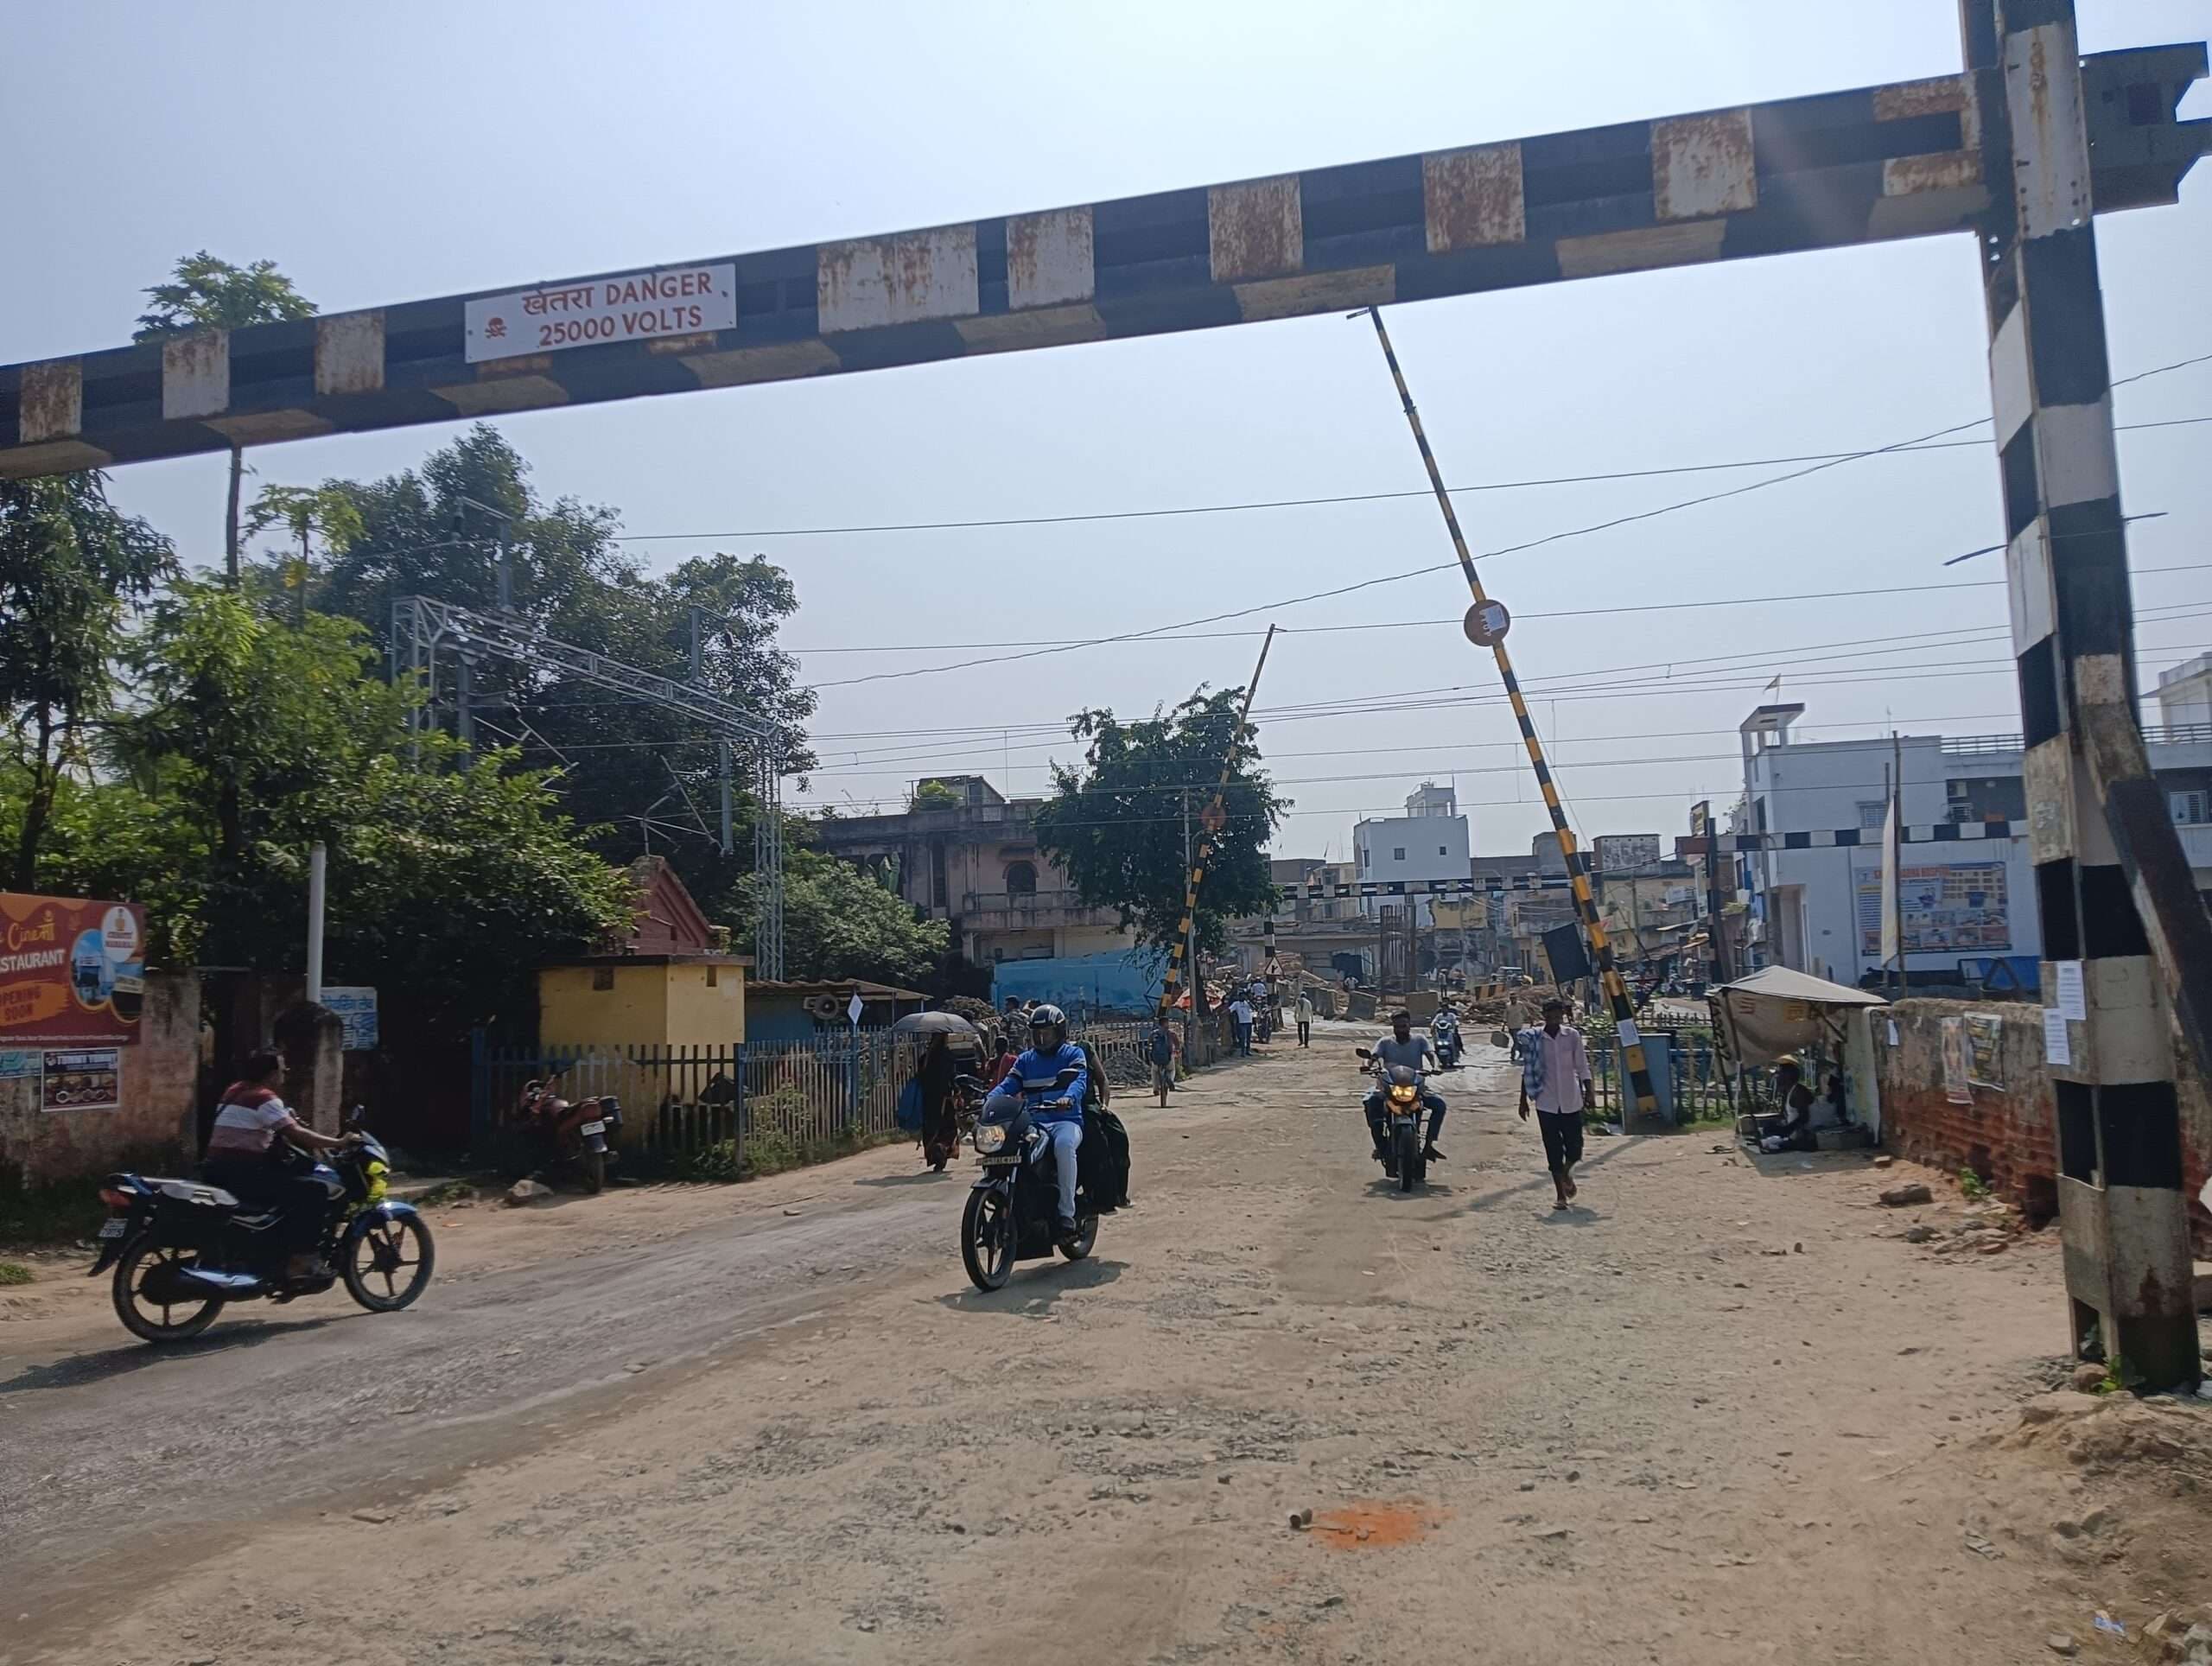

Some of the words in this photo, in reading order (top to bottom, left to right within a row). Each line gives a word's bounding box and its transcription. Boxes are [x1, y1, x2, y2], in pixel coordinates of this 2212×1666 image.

[607, 272, 711, 305] DANGER
[539, 316, 614, 346] 25000
[621, 306, 702, 334] VOLTS
